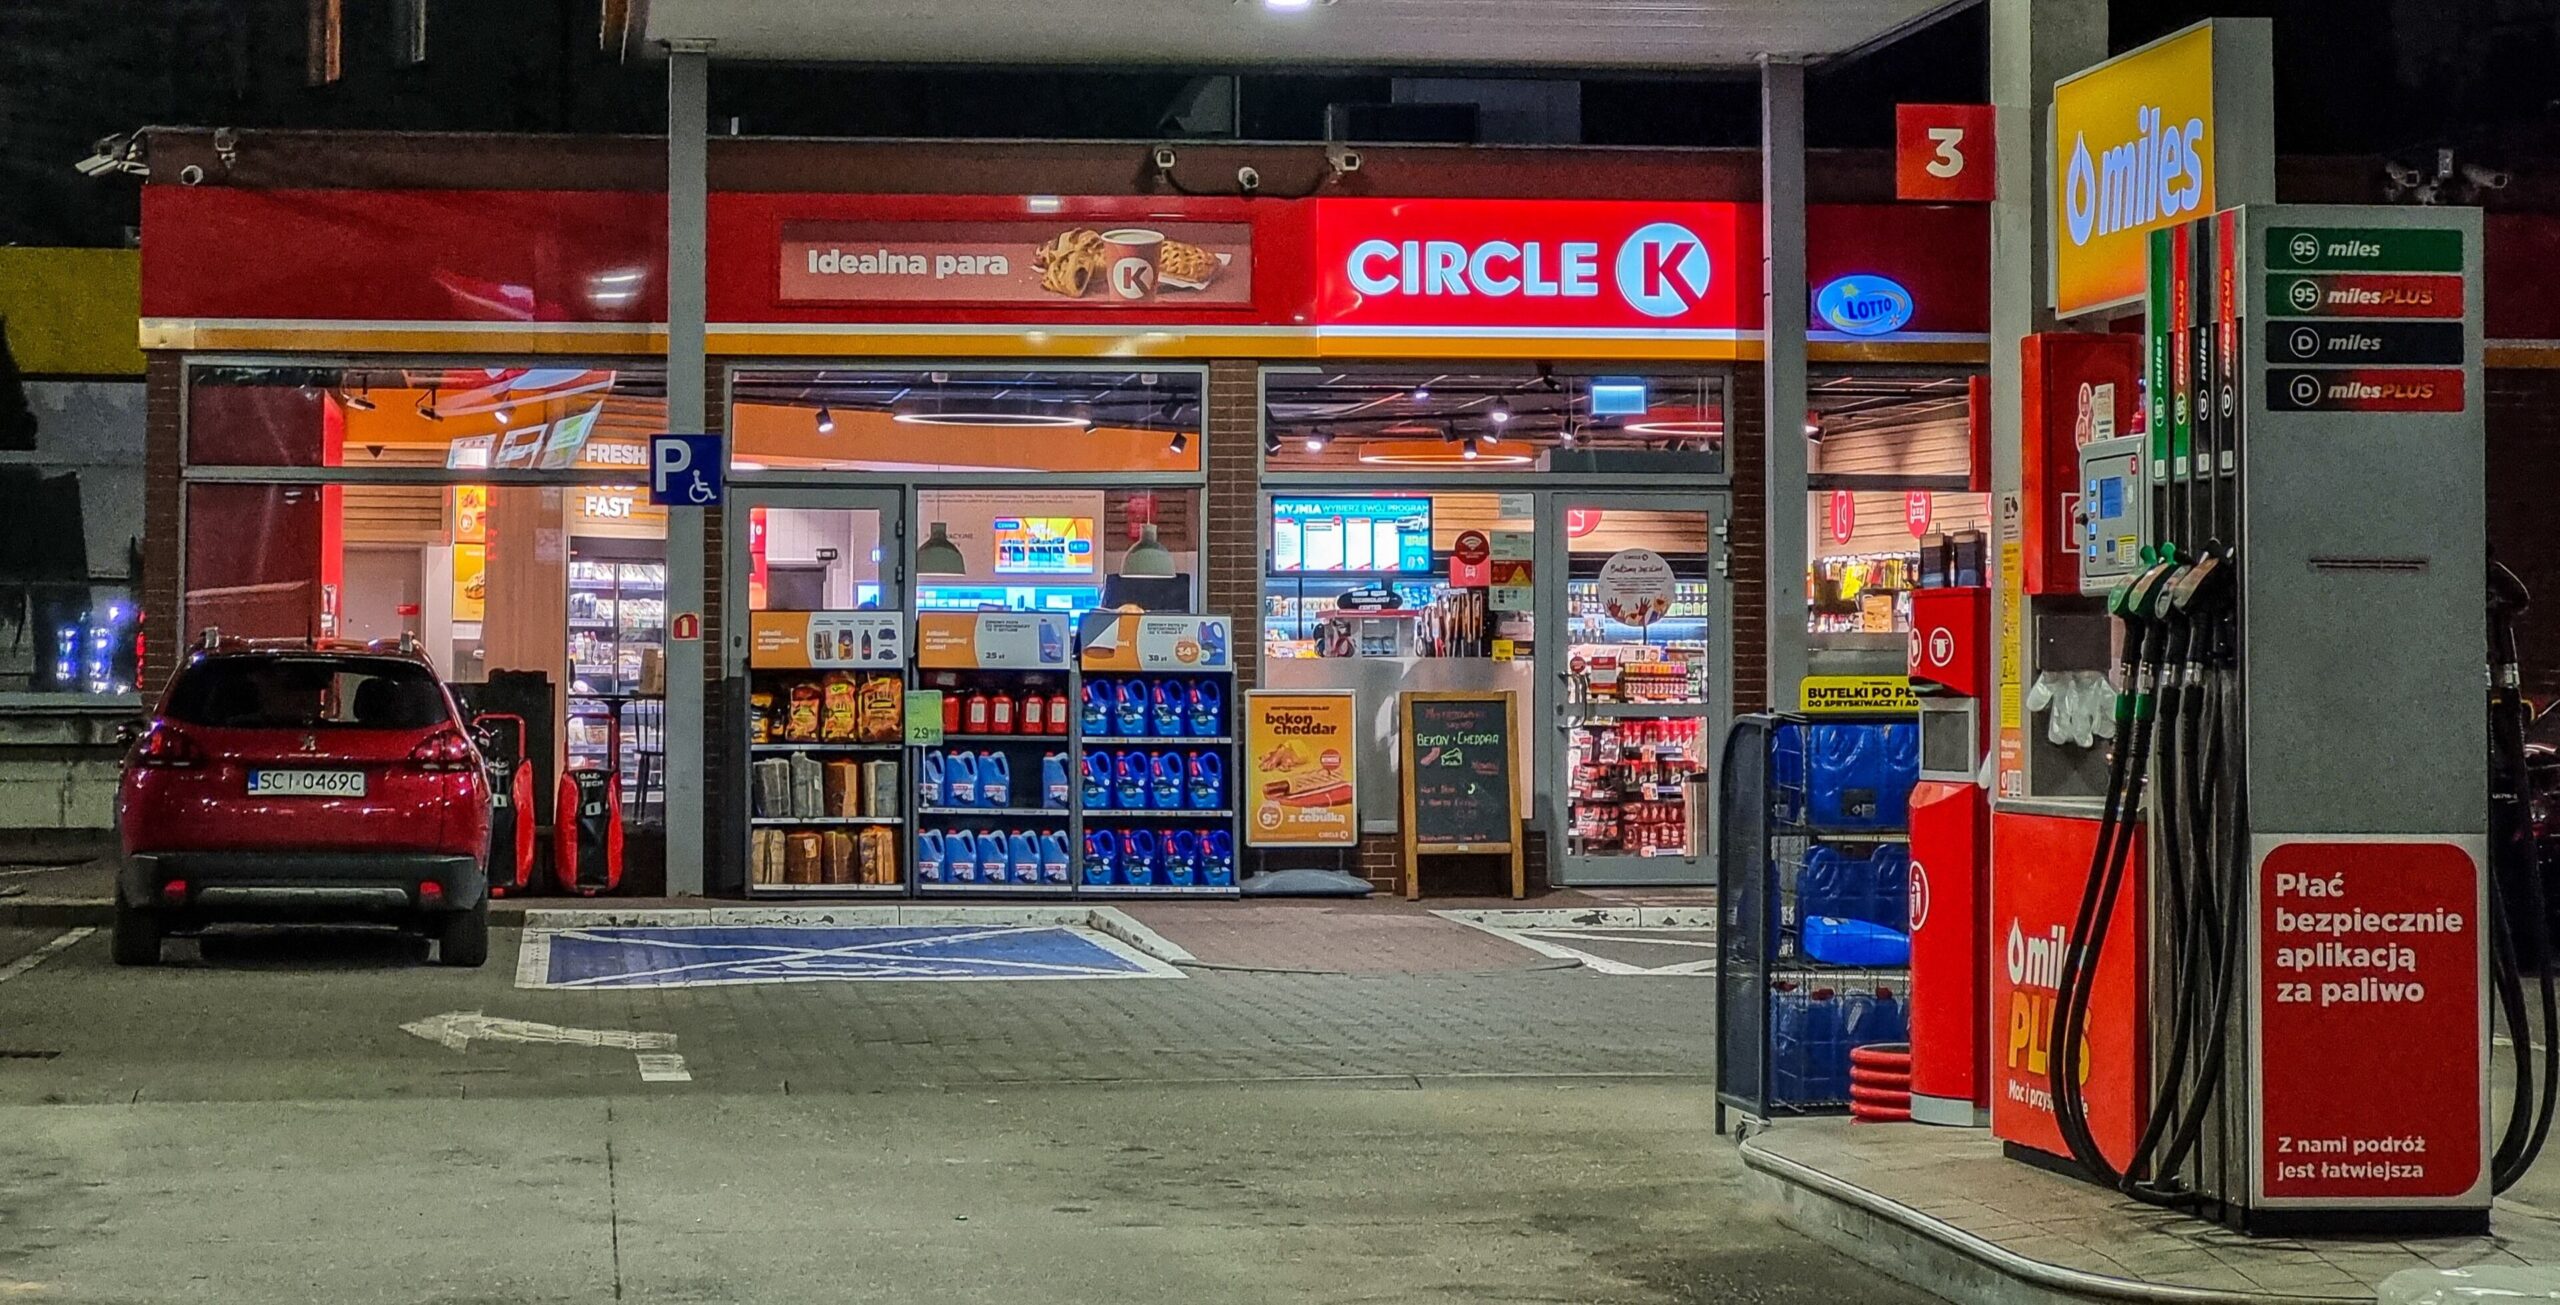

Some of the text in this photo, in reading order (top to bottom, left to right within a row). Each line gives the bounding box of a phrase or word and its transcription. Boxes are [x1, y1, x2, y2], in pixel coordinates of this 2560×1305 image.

[1925, 127, 1964, 178] 3
[2098, 105, 2204, 236] miles
[2293, 241, 2380, 257] 95 miles
[808, 249, 1010, 280] Idealna para
[1347, 239, 1599, 296] CIRCLE
[2294, 288, 2433, 305] 95 milesPLUS
[1847, 297, 1892, 320] LOTTO
[2297, 334, 2381, 351] D miles
[2298, 383, 2435, 399] D milesPLUS
[586, 443, 647, 464] FRESH
[655, 439, 691, 492] P
[585, 495, 633, 518] FAST
[1274, 503, 1321, 514] MYJNIA
[1808, 687, 1868, 698] BUTELKI
[1871, 687, 1892, 698] PO
[1265, 712, 1313, 725] bekon
[1273, 722, 1337, 735] cheddar
[1416, 733, 1450, 747] BEKON
[260, 772, 361, 791] SCI 0469C
[2276, 872, 2345, 898] Płać
[2276, 907, 2464, 937] bezpiecznie
[2025, 925, 2087, 992] mil
[2276, 942, 2417, 973] aplikacją
[2276, 977, 2426, 1007] za paliwo
[2009, 1078, 2024, 1102] Moc
[2025, 1082, 2030, 1104] i
[2278, 1135, 2426, 1157] Z nami podróż
[2277, 1160, 2424, 1182] jest łatwiejsza
